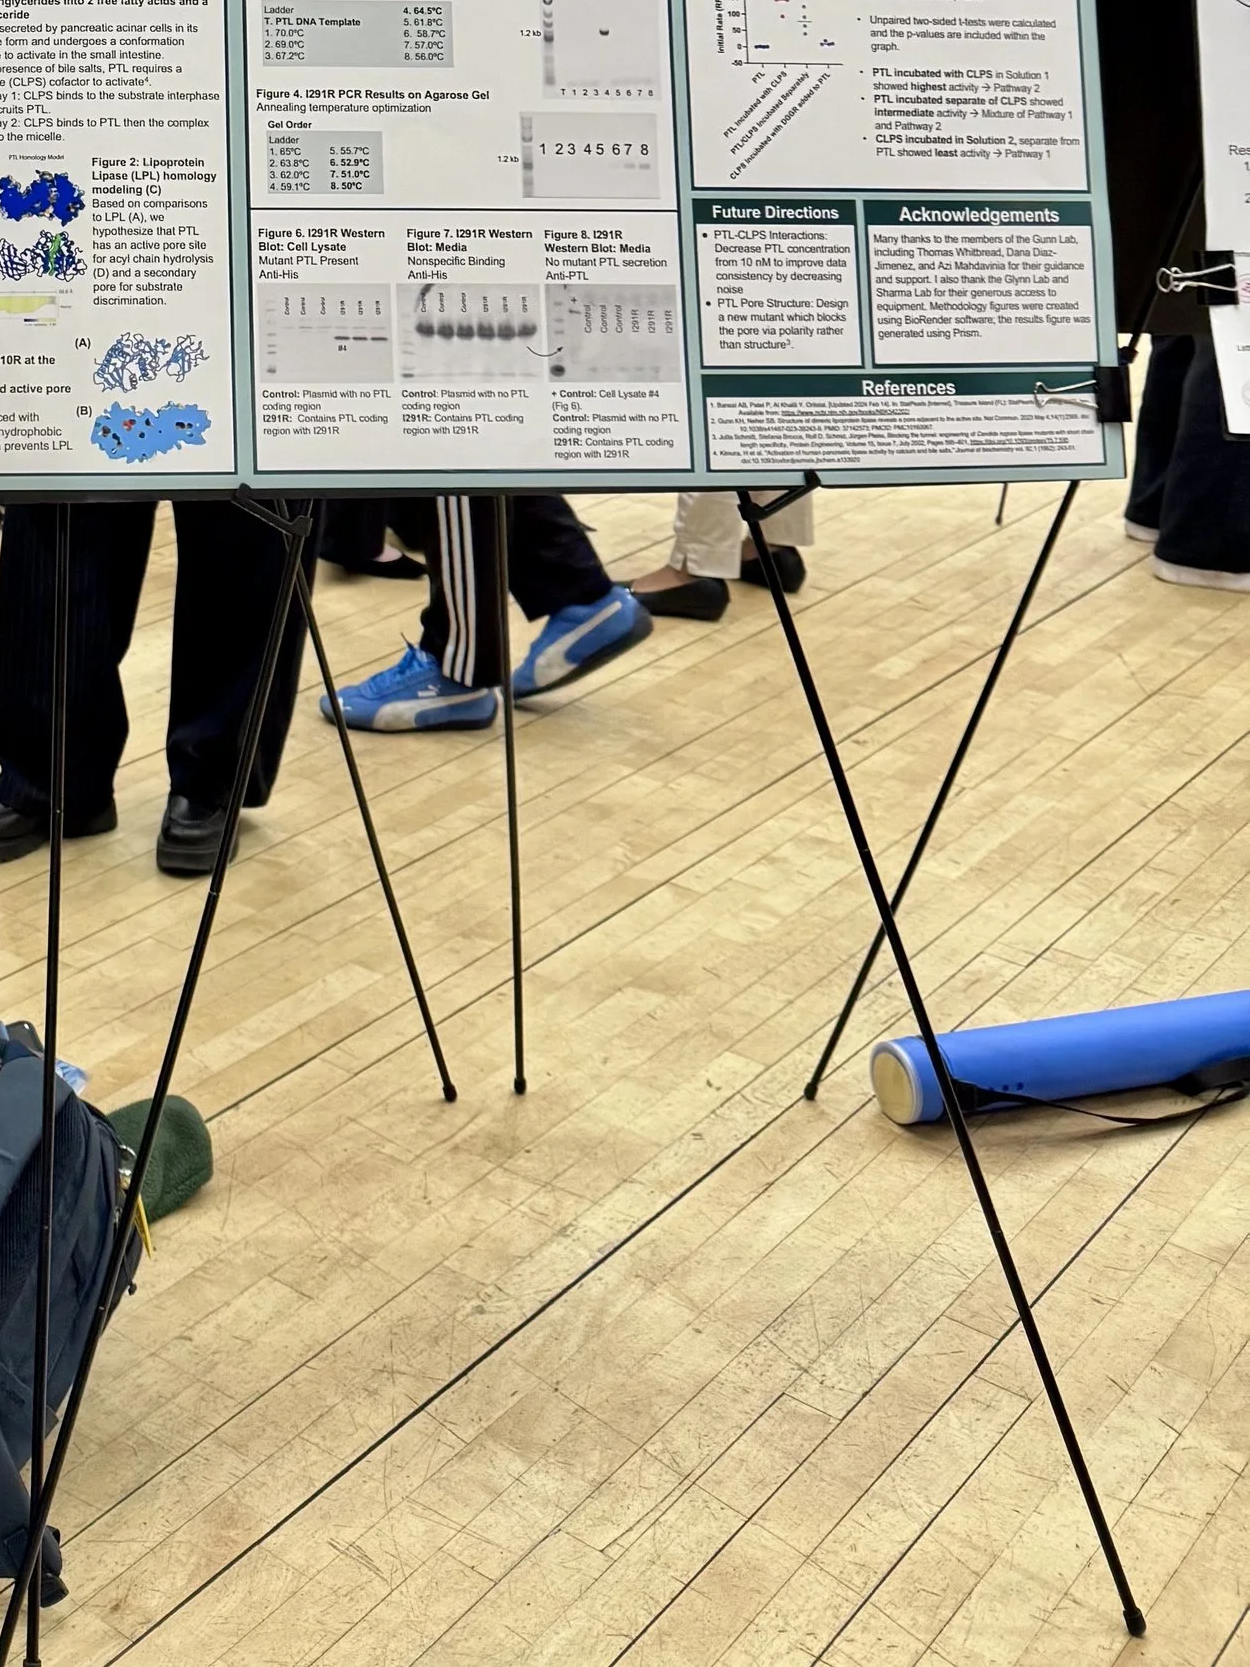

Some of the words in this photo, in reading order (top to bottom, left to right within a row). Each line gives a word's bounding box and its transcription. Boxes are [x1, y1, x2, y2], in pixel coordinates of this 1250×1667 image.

[0, 23, 42, 32] secreted
[45, 23, 57, 33] by
[60, 23, 113, 33] pancreatic
[116, 23, 146, 31] acinar
[150, 23, 172, 31] cells
[175, 23, 183, 31] in
[187, 23, 198, 32] its
[92, 157, 126, 168] Figure
[130, 157, 140, 165] 2:
[143, 157, 204, 168] Lipoprotein
[92, 170, 127, 181] Lipase
[131, 171, 159, 181] (LPL)
[163, 171, 216, 182] homology
[712, 205, 760, 218] Future
[765, 205, 838, 218] Directions
[898, 207, 1060, 223] Acknowledgements
[258, 228, 291, 239] Figure
[295, 228, 304, 237] 6.
[340, 228, 384, 237] Western
[714, 230, 766, 239] PTL-CLPS
[769, 230, 826, 239] Interactions:
[873, 234, 898, 244] Many
[900, 234, 930, 242] thanks
[961, 235, 1002, 243] members
[1005, 234, 1013, 243] of
[1016, 235, 1030, 243] the
[1032, 234, 1056, 243] Gunn
[1059, 235, 1078, 243] Lab,
[258, 242, 283, 250] Blot:
[287, 242, 307, 250] Cell
[311, 242, 345, 253] Lysate
[715, 243, 761, 252] Decrease
[764, 243, 784, 252] PTL
[787, 245, 850, 253] concentration
[373, 389, 390, 397] PTL
[862, 380, 957, 395] References
